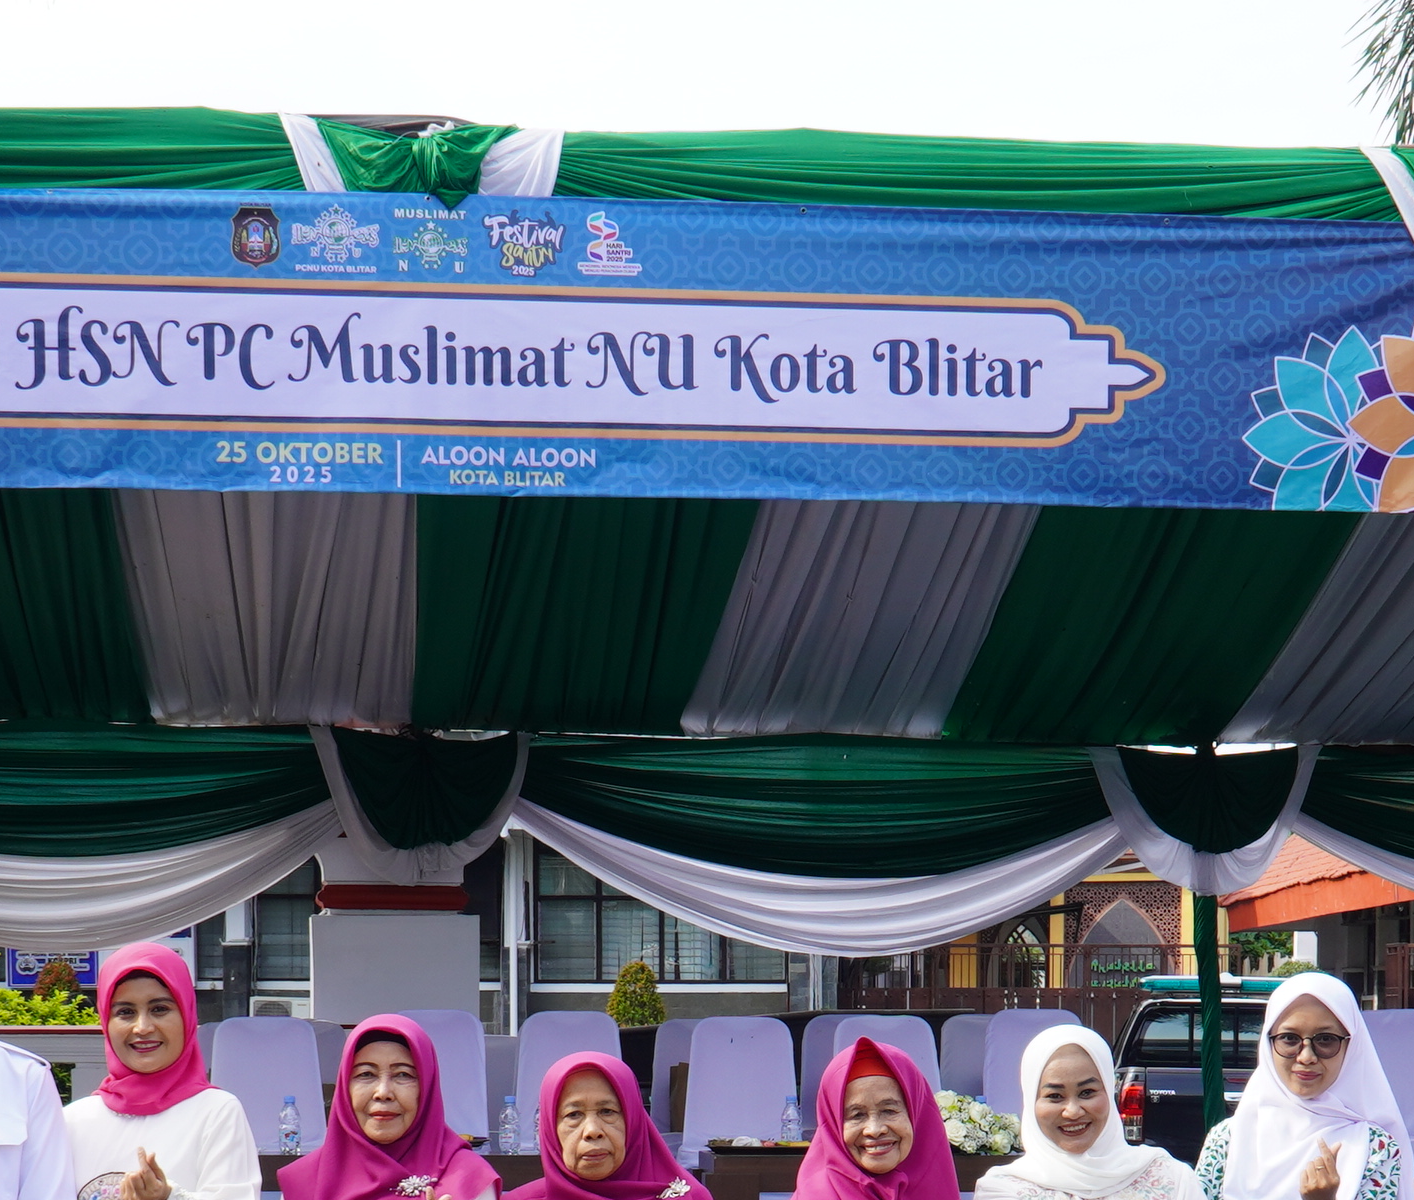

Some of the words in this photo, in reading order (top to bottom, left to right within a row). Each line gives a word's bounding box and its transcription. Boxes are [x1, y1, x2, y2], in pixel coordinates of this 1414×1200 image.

[394, 208, 467, 220] MUSLIMAT
[483, 215, 564, 249] Festival
[295, 264, 320, 273] PCNU
[321, 265, 345, 273] KOTA
[346, 265, 377, 273] BLITAR
[398, 259, 409, 272] N
[454, 261, 464, 273] U
[512, 265, 535, 276] 2025
[14, 305, 179, 391] HSN
[186, 319, 276, 392] PC
[288, 312, 575, 388] Muslimat
[586, 332, 699, 396] NU
[713, 333, 857, 403] Kota
[873, 338, 1043, 399] Blitar
[216, 441, 247, 464] 25
[256, 441, 384, 465] OKTOBER
[421, 446, 505, 467] ALOON
[512, 447, 597, 469] ALOON
[269, 465, 332, 484] 2025
[449, 469, 499, 486] KOTA
[503, 471, 566, 488] BLITAR
